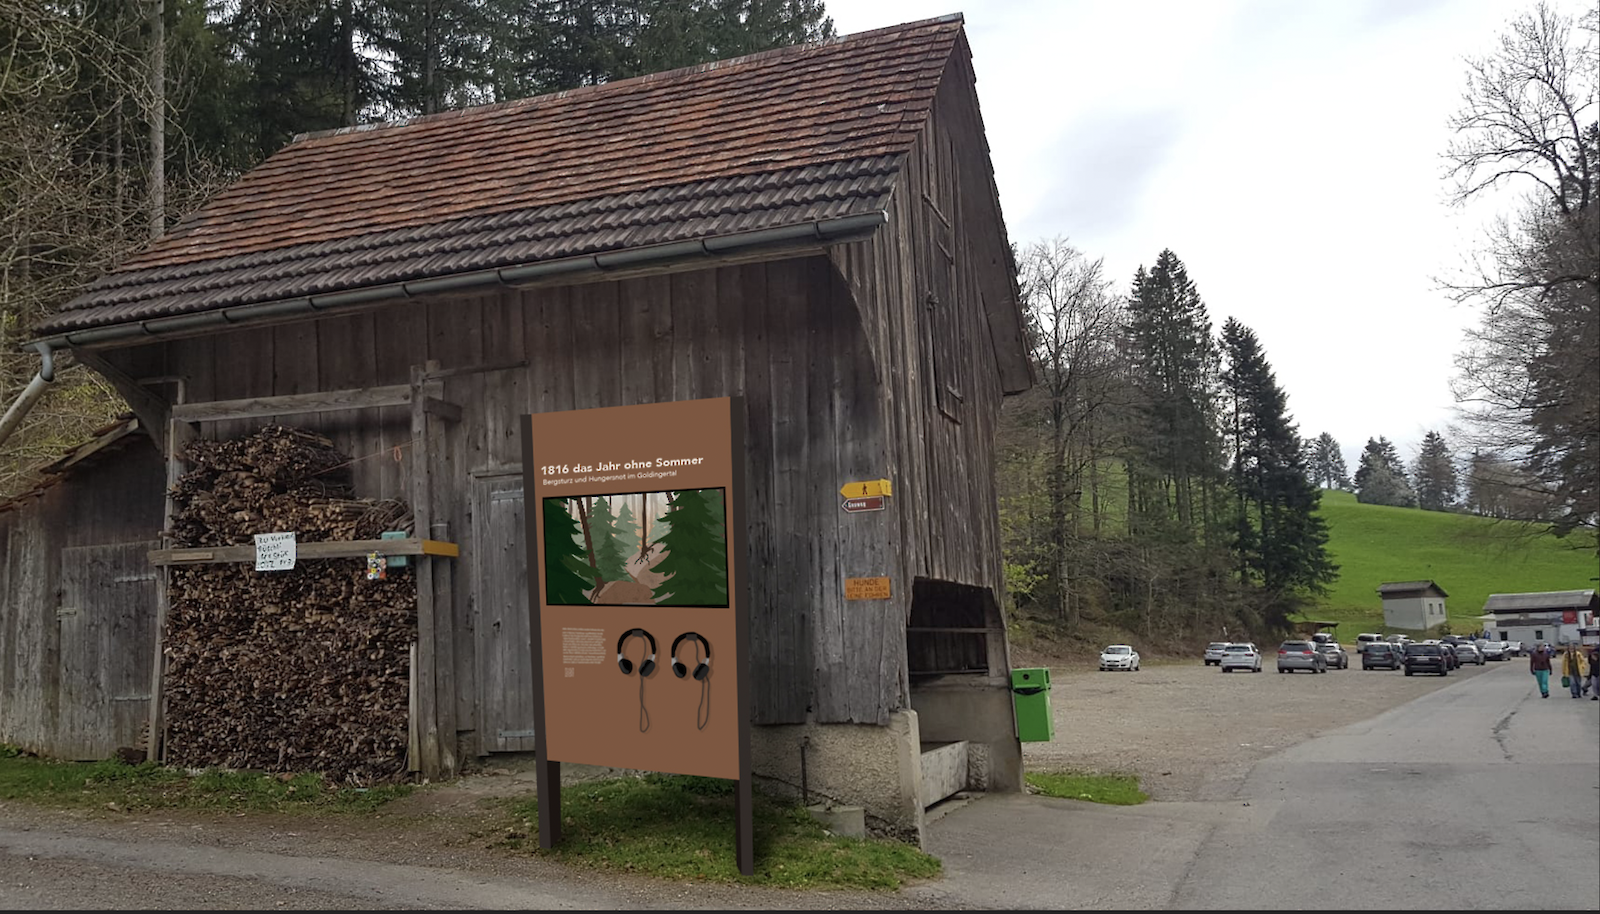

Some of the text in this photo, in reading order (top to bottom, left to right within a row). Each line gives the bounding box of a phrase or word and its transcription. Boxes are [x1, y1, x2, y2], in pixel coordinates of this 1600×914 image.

[541, 457, 704, 475] 1816 das Jahr ohne Sommer
[543, 478, 573, 486] Bergsturz
[588, 474, 626, 482] Hungersnot
[637, 469, 678, 479] Goldingertal
[853, 578, 879, 586] HUNDE
